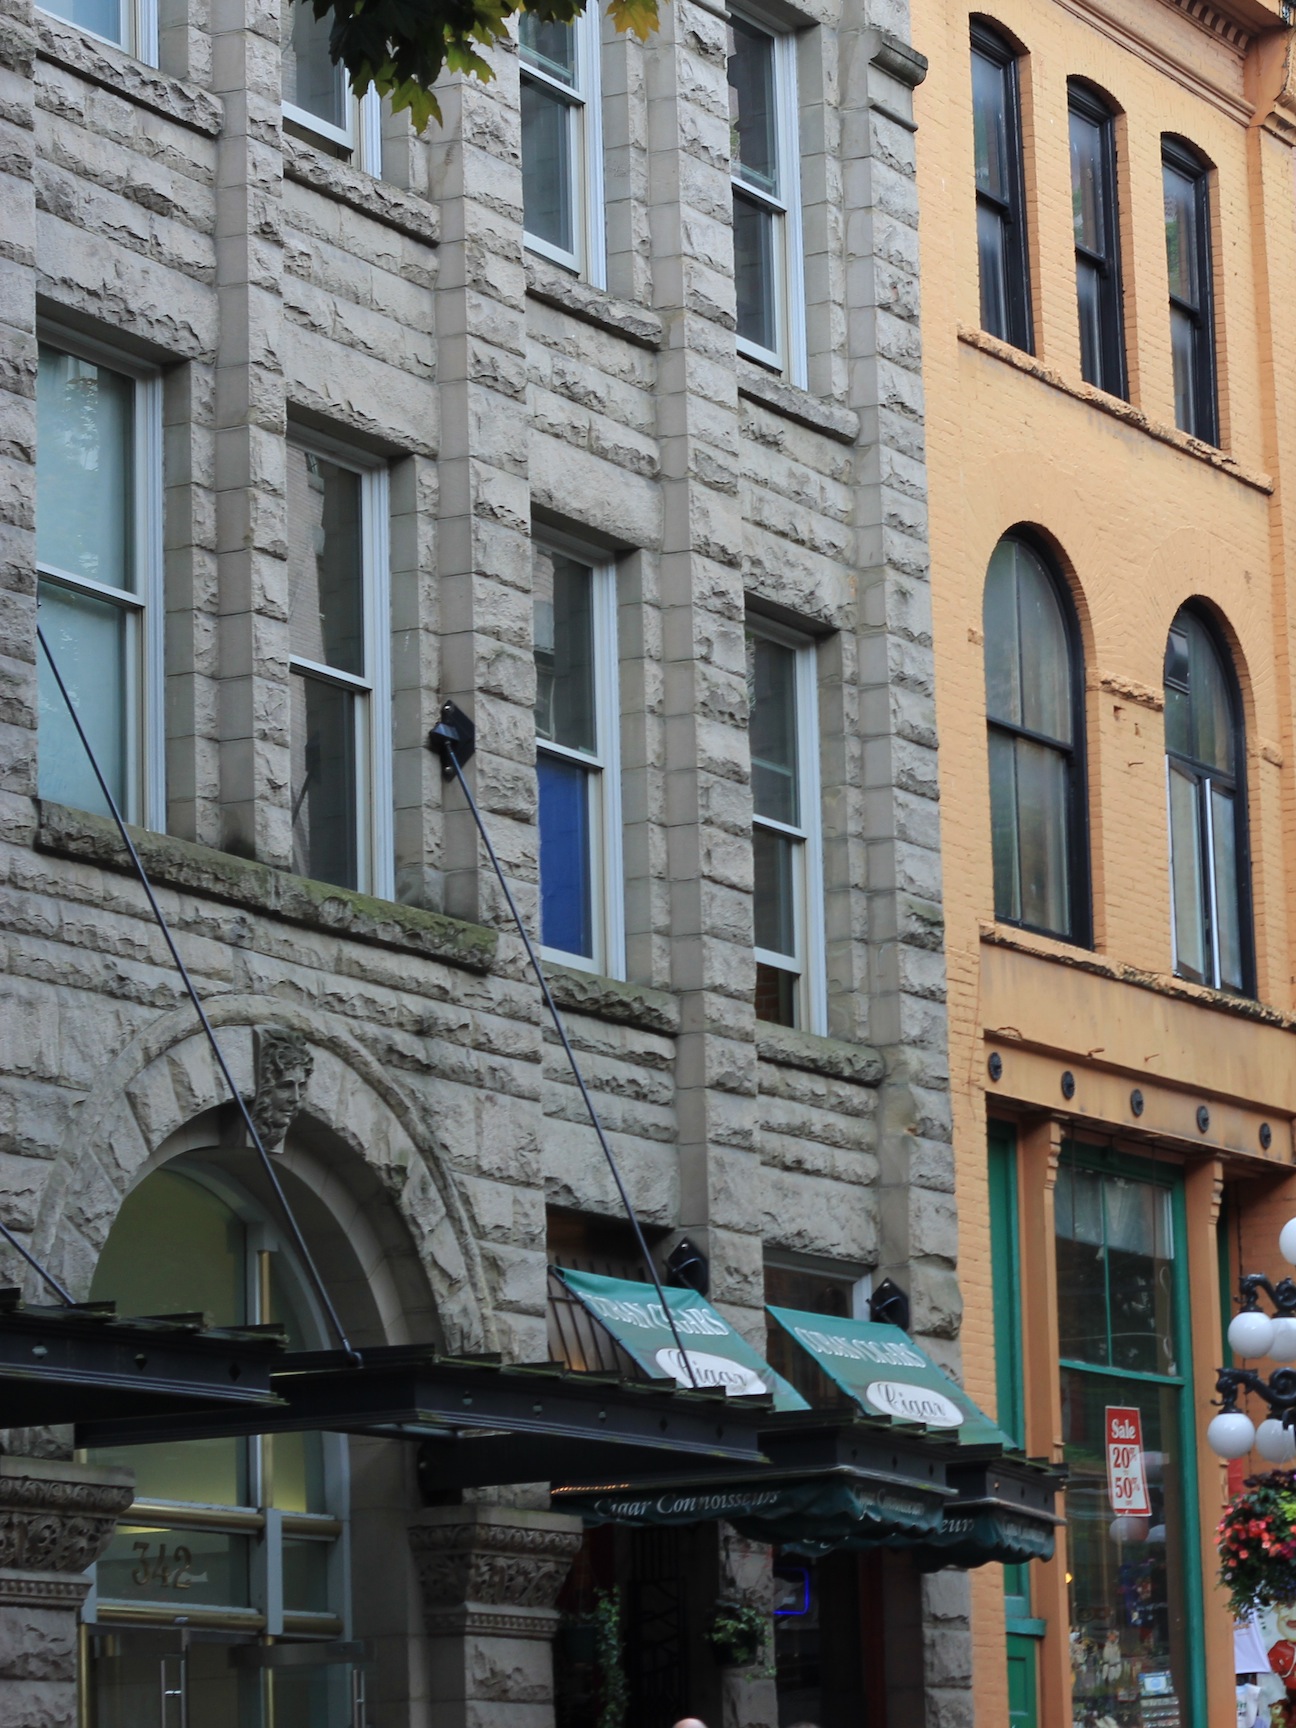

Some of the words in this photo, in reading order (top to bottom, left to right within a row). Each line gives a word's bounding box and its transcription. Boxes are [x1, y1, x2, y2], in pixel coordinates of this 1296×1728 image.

[878, 1383, 946, 1419] Cigar
[1111, 1418, 1136, 1439] Sale
[132, 1541, 192, 1589] 342
